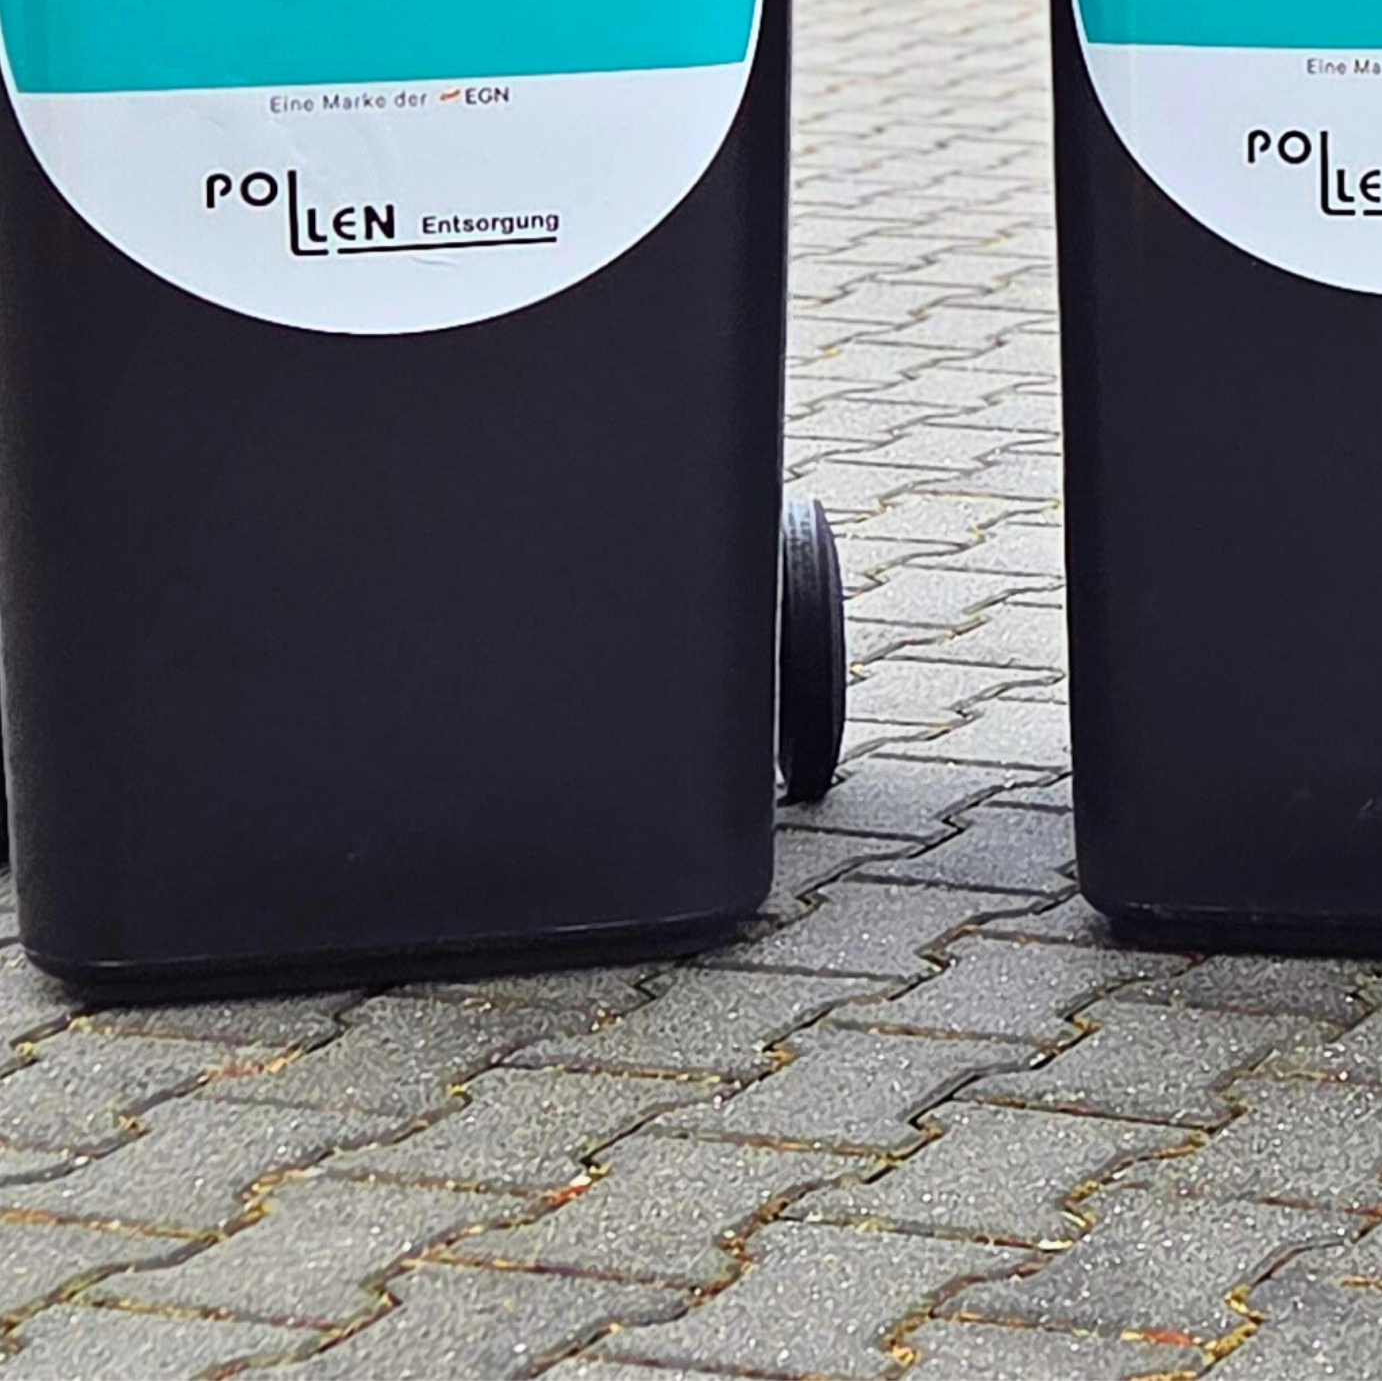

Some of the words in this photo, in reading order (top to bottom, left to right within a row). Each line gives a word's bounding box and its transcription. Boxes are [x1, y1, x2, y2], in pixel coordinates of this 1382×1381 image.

[1307, 58, 1346, 76] Eine
[270, 94, 314, 114] Eine
[322, 93, 386, 111] Marke
[394, 90, 428, 108] der
[465, 86, 510, 105] EGN
[205, 169, 396, 257] POLLEN
[422, 213, 560, 237] Entsorgung
